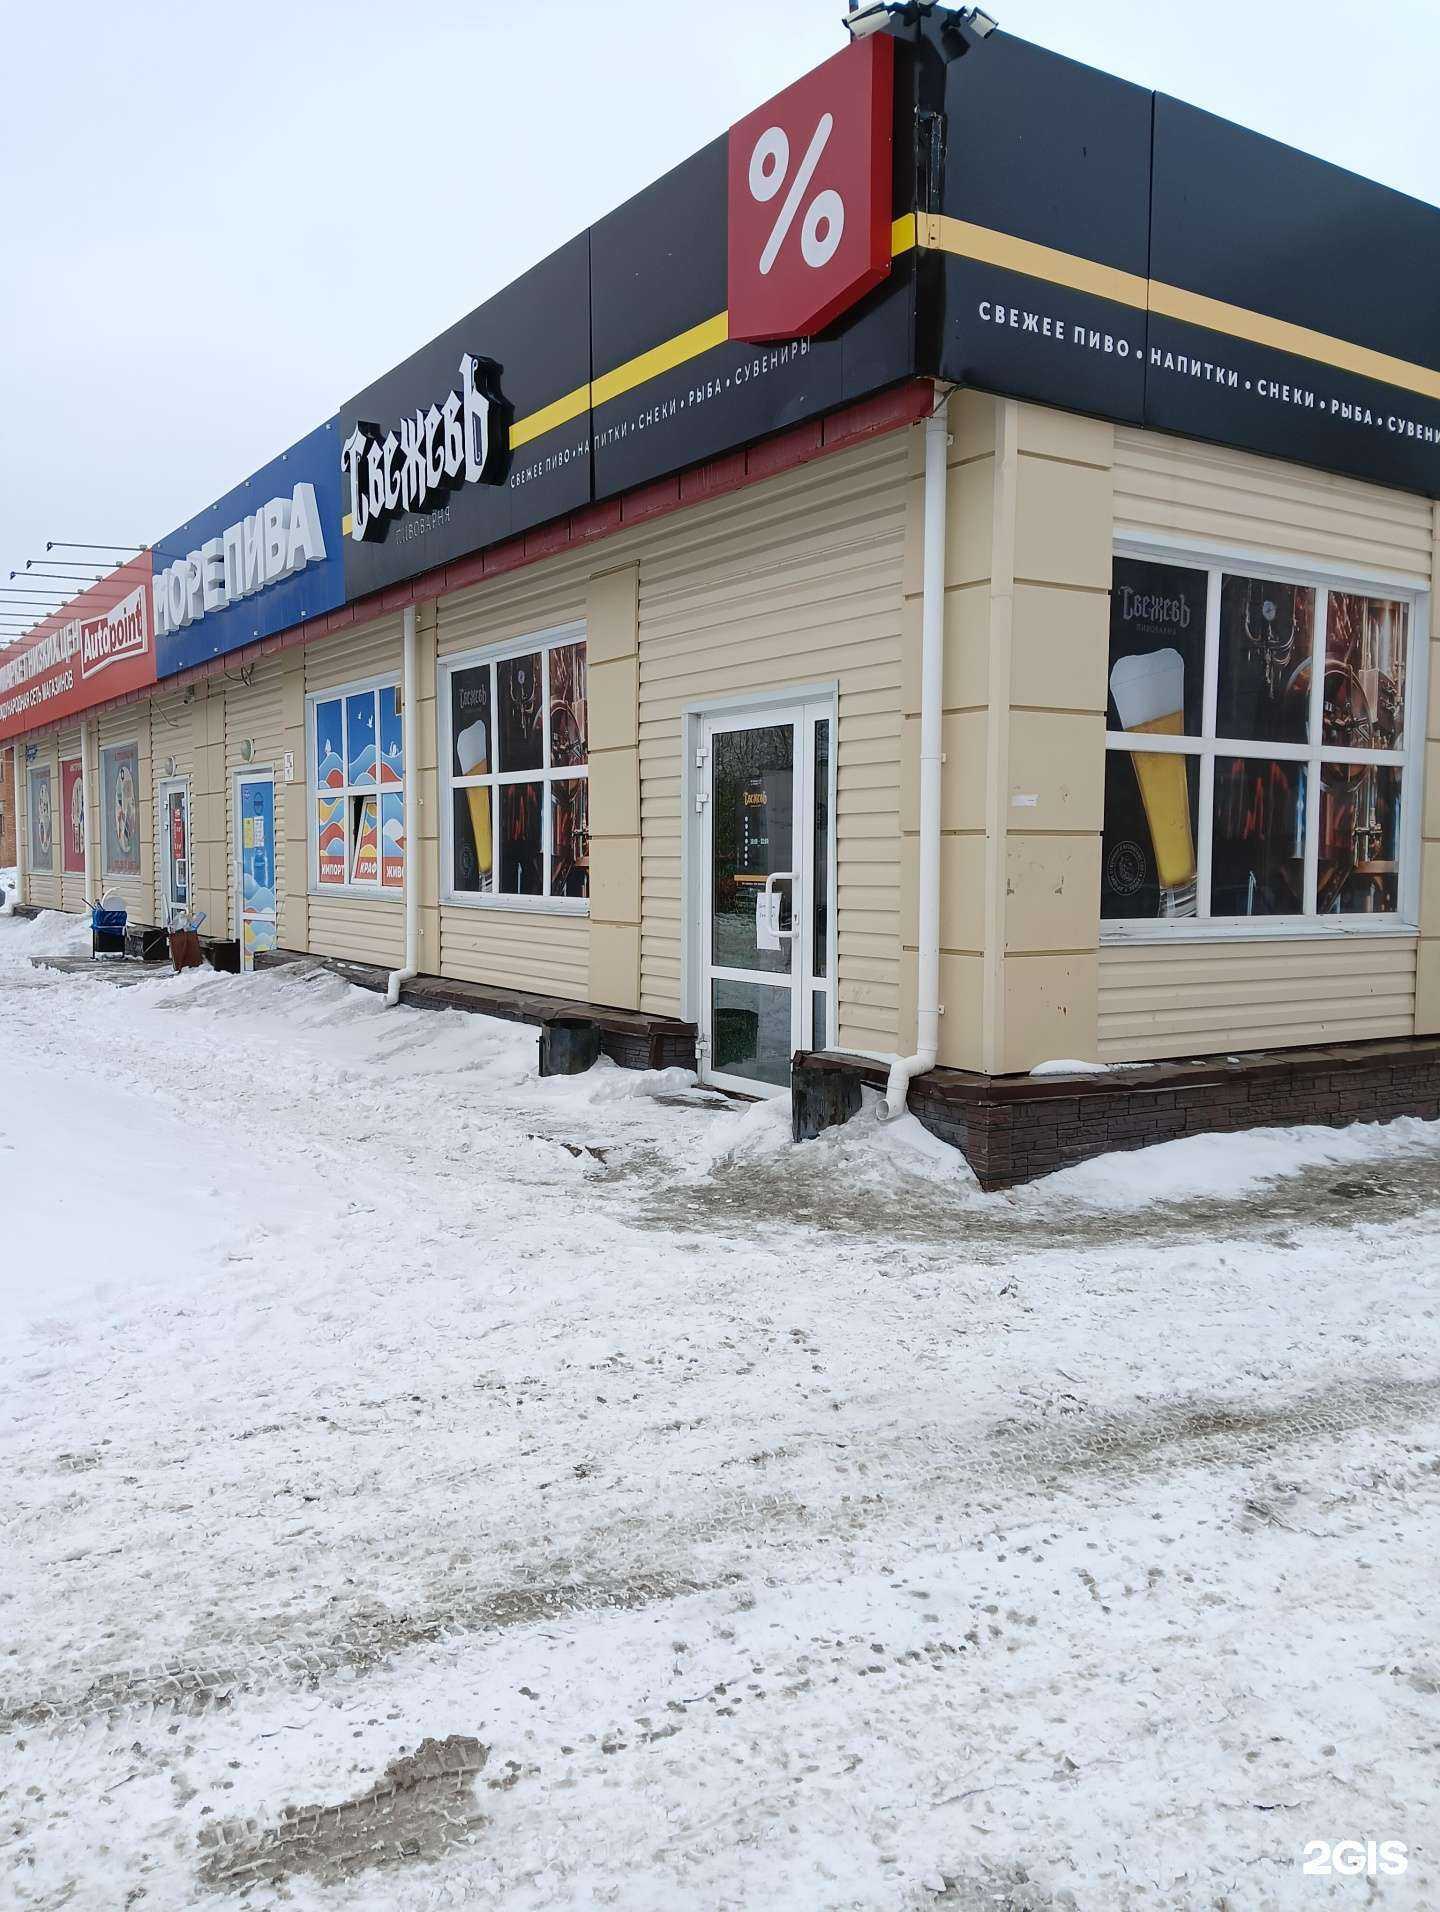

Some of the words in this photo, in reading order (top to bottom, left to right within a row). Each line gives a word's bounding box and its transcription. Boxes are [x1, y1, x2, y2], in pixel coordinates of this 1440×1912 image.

[510, 462, 543, 489] СВЕЖЕЕ
[545, 449, 570, 472] ПИВО
[577, 421, 628, 456] НАПИТКИ
[638, 397, 676, 430] СНЕКИ
[688, 378, 722, 407] РЫБА
[735, 335, 811, 385] СУВЕНИРЫ
[978, 301, 1065, 340] СВЕЖЕЕ
[1073, 325, 1130, 357] ПИВО
[1150, 347, 1239, 388] НАПИТКИ
[1257, 379, 1315, 408] СНЕКИ
[1331, 399, 1373, 425] РЫБА
[321, 863, 344, 876] ИМПОРТ
